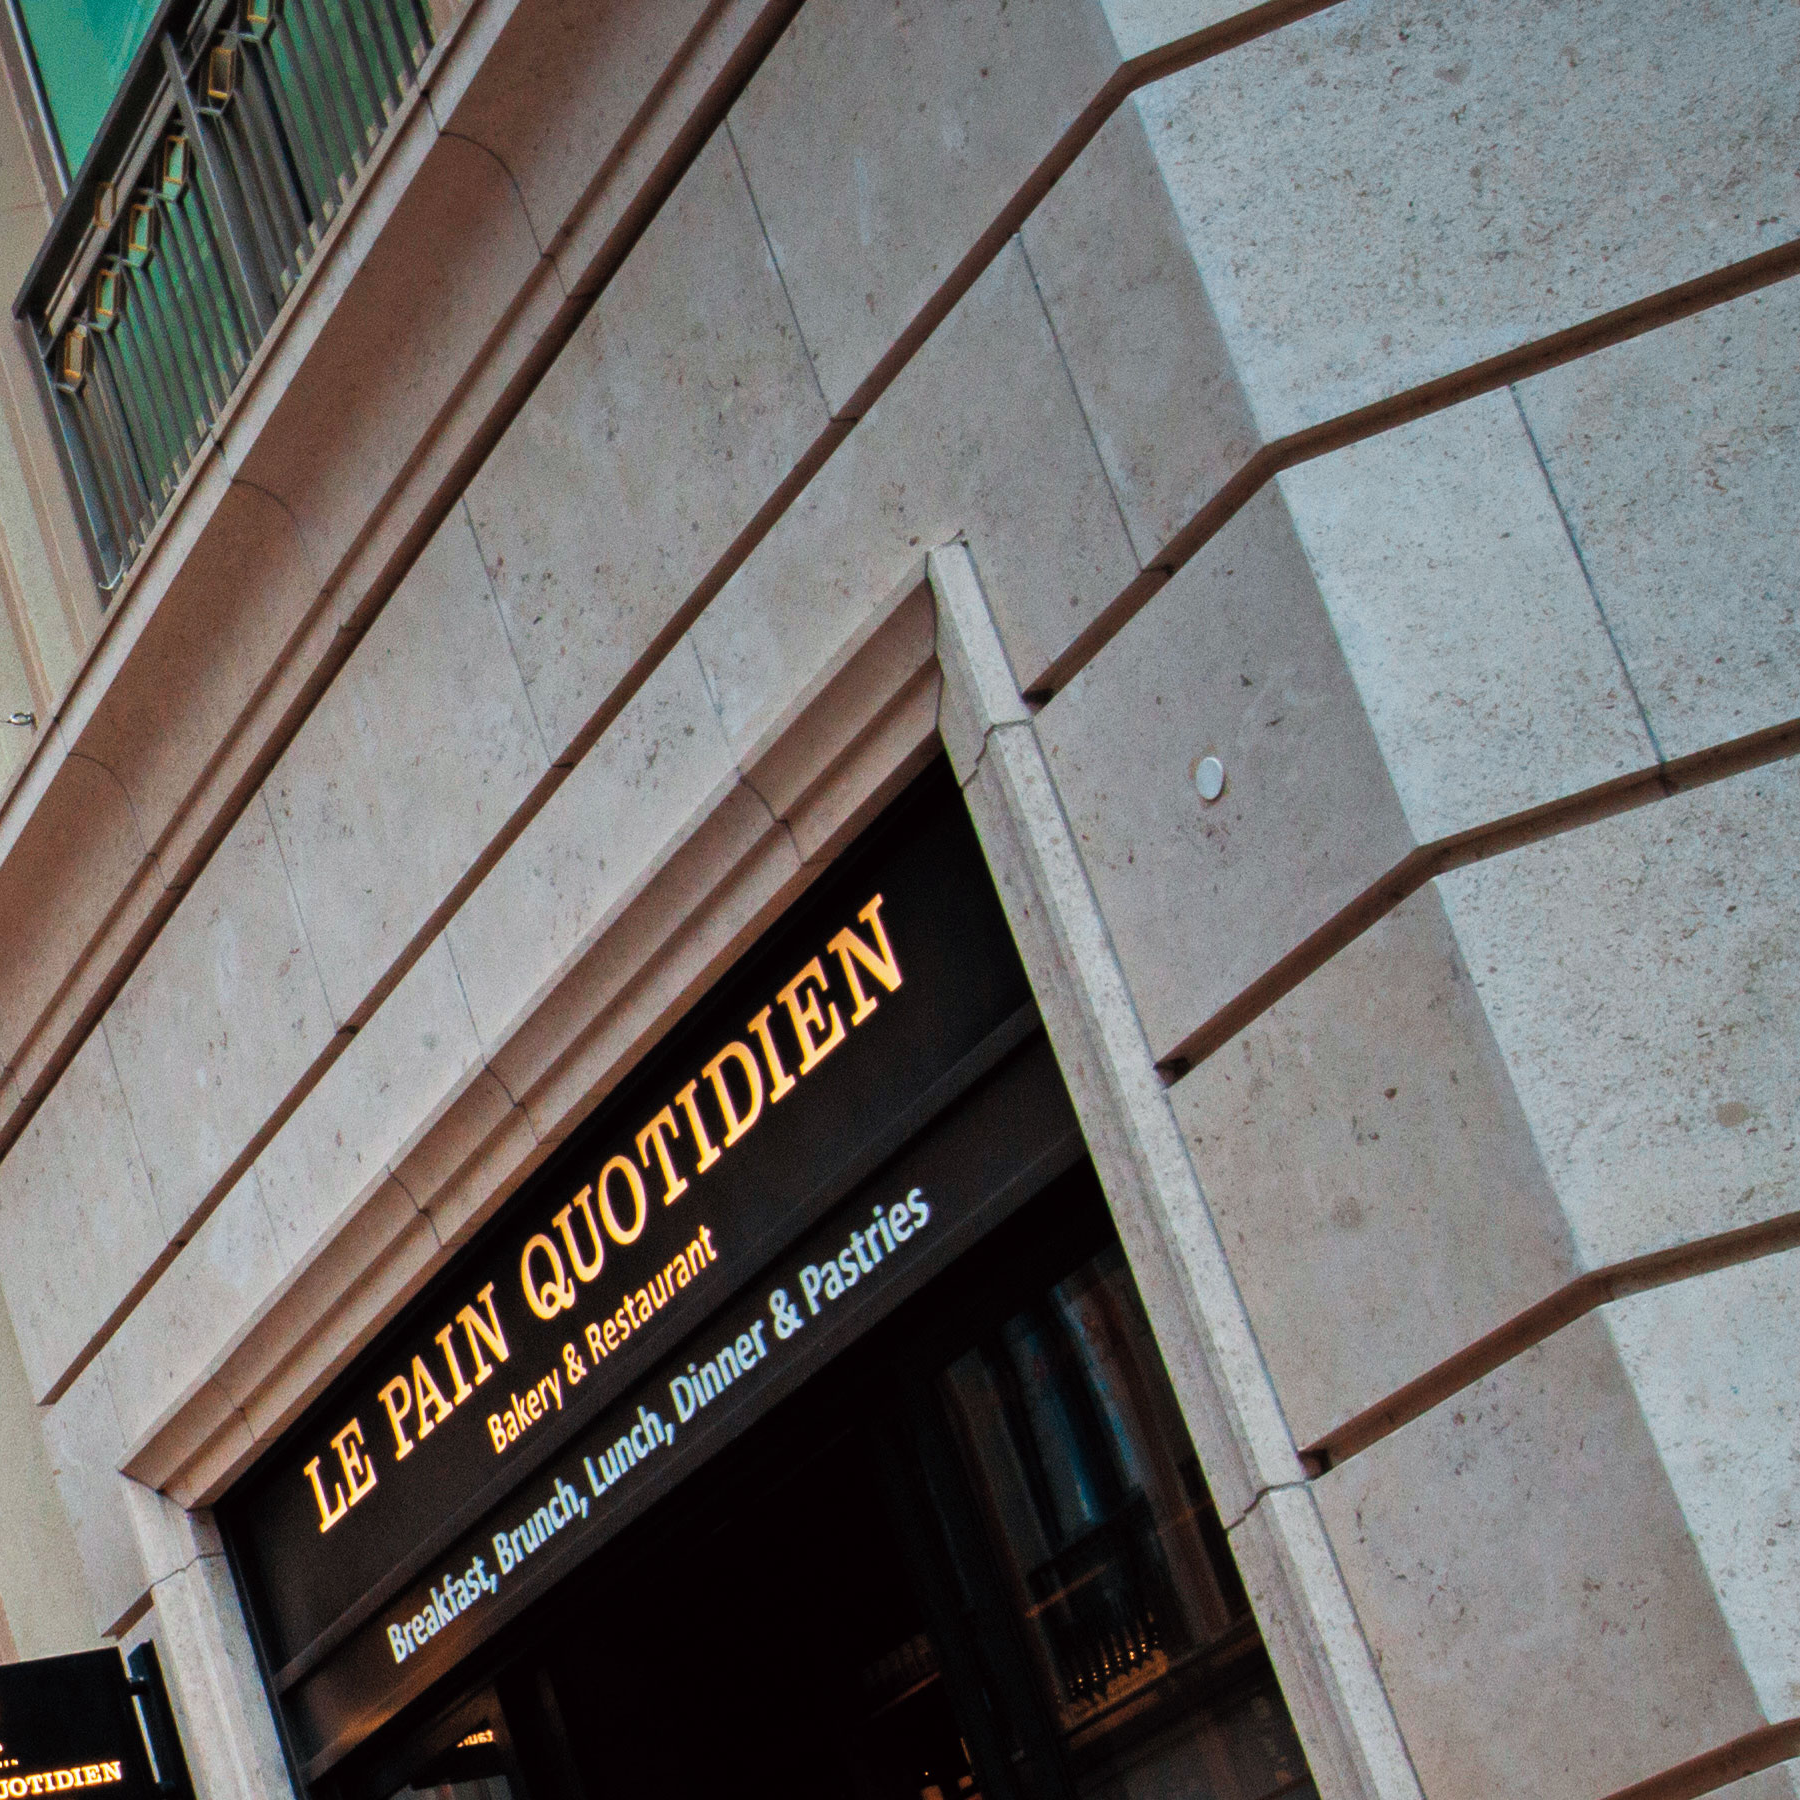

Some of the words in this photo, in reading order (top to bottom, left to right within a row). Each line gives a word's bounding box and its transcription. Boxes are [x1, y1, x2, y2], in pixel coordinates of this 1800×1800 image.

[303, 1416, 379, 1534] LE
[378, 1281, 511, 1461] PAIN
[520, 893, 903, 1320] QUOTIDIEN
[387, 1555, 497, 1663] Breakfast,
[492, 1477, 588, 1575] Brunch,
[583, 1405, 676, 1497] Lunch,
[669, 1319, 768, 1423] Dinner
[769, 1288, 804, 1340] &
[799, 1187, 931, 1315] Pastries
[487, 1368, 562, 1454] Bakery
[562, 1342, 587, 1386] &
[584, 1224, 717, 1365] Restaurant
